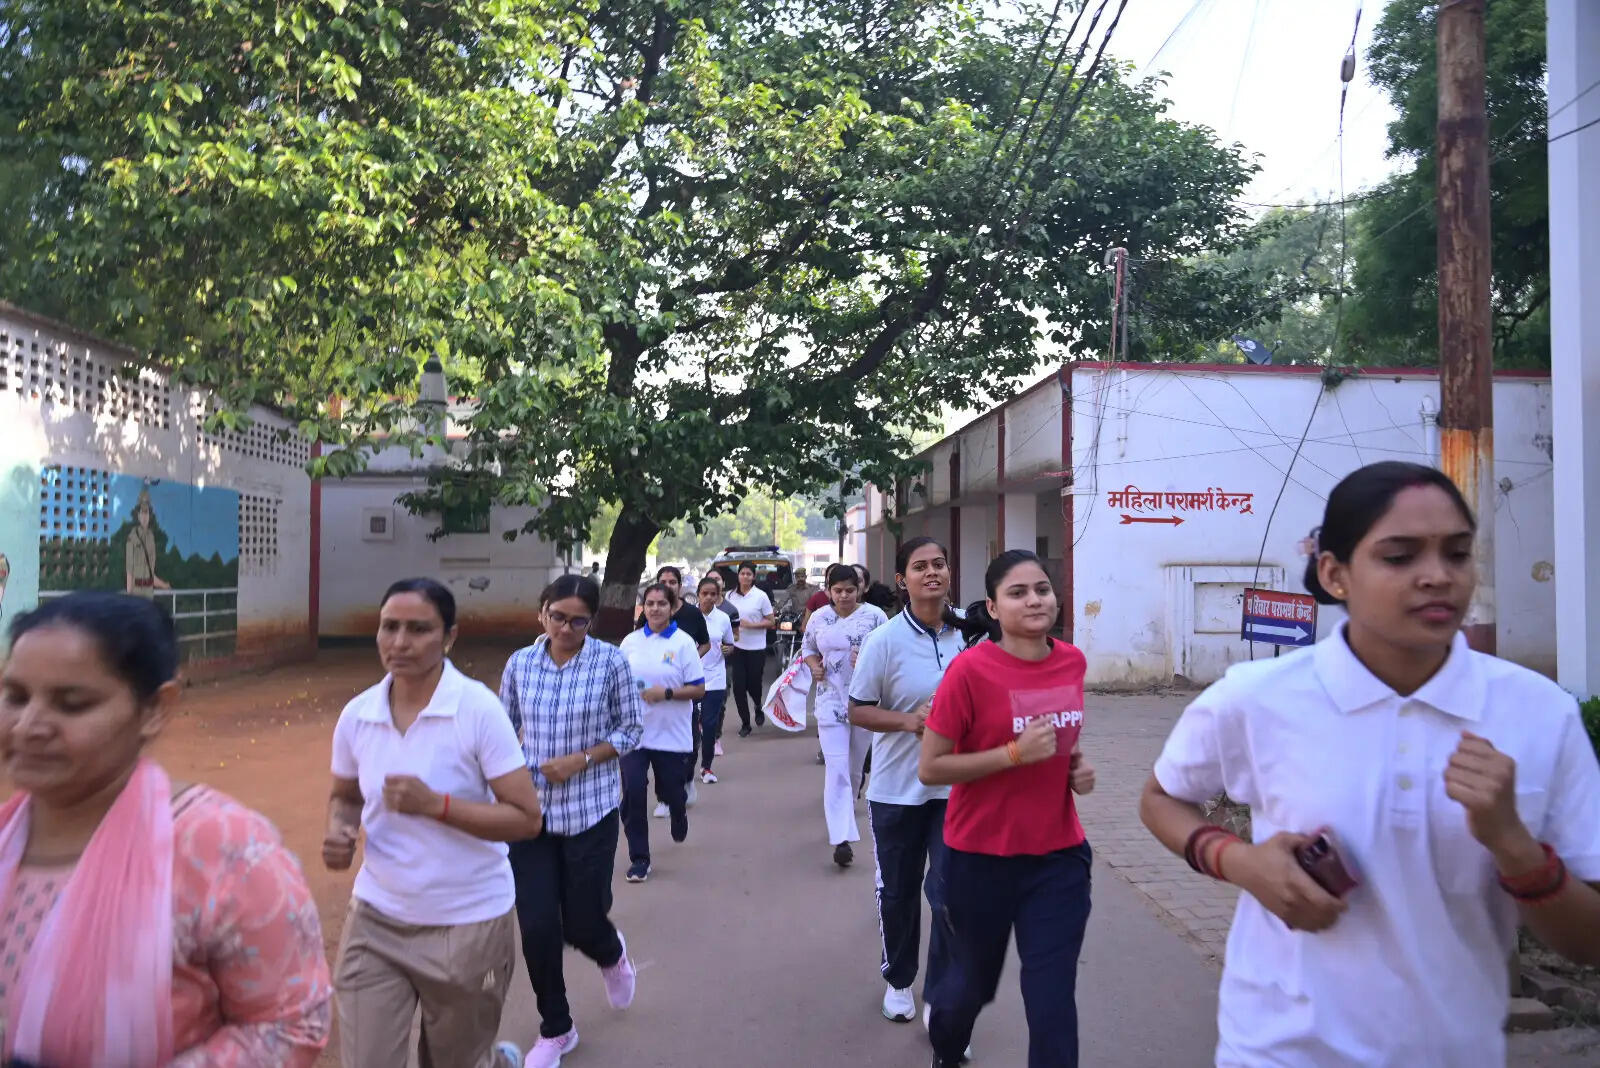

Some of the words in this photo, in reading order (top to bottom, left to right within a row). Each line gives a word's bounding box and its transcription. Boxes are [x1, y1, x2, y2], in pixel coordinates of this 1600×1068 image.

[1107, 485, 1163, 513] महिला
[1164, 487, 1214, 511] परामर्श
[1216, 487, 1254, 514] केन्द्र
